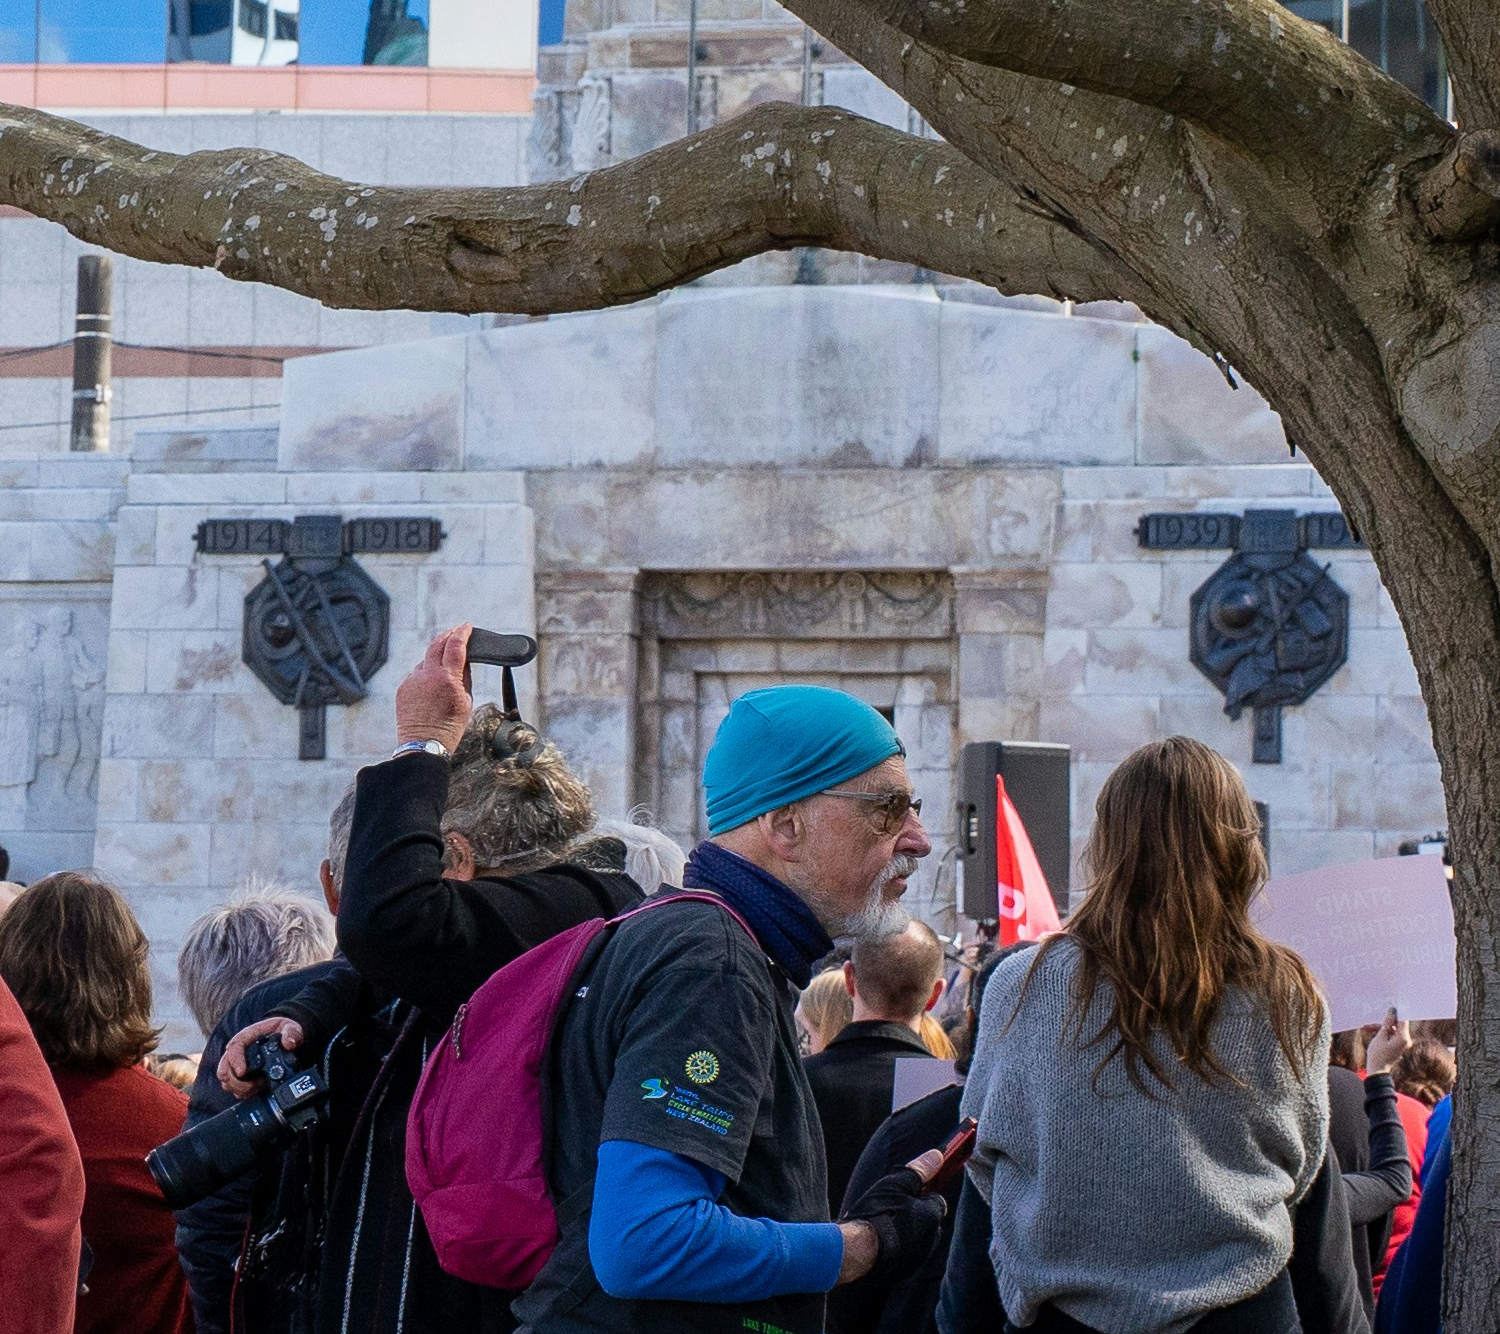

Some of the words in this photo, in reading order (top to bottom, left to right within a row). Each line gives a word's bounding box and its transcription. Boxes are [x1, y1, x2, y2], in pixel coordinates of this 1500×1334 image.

[210, 521, 277, 551] 1914
[360, 520, 425, 550] 1918
[1152, 516, 1222, 546] 1939
